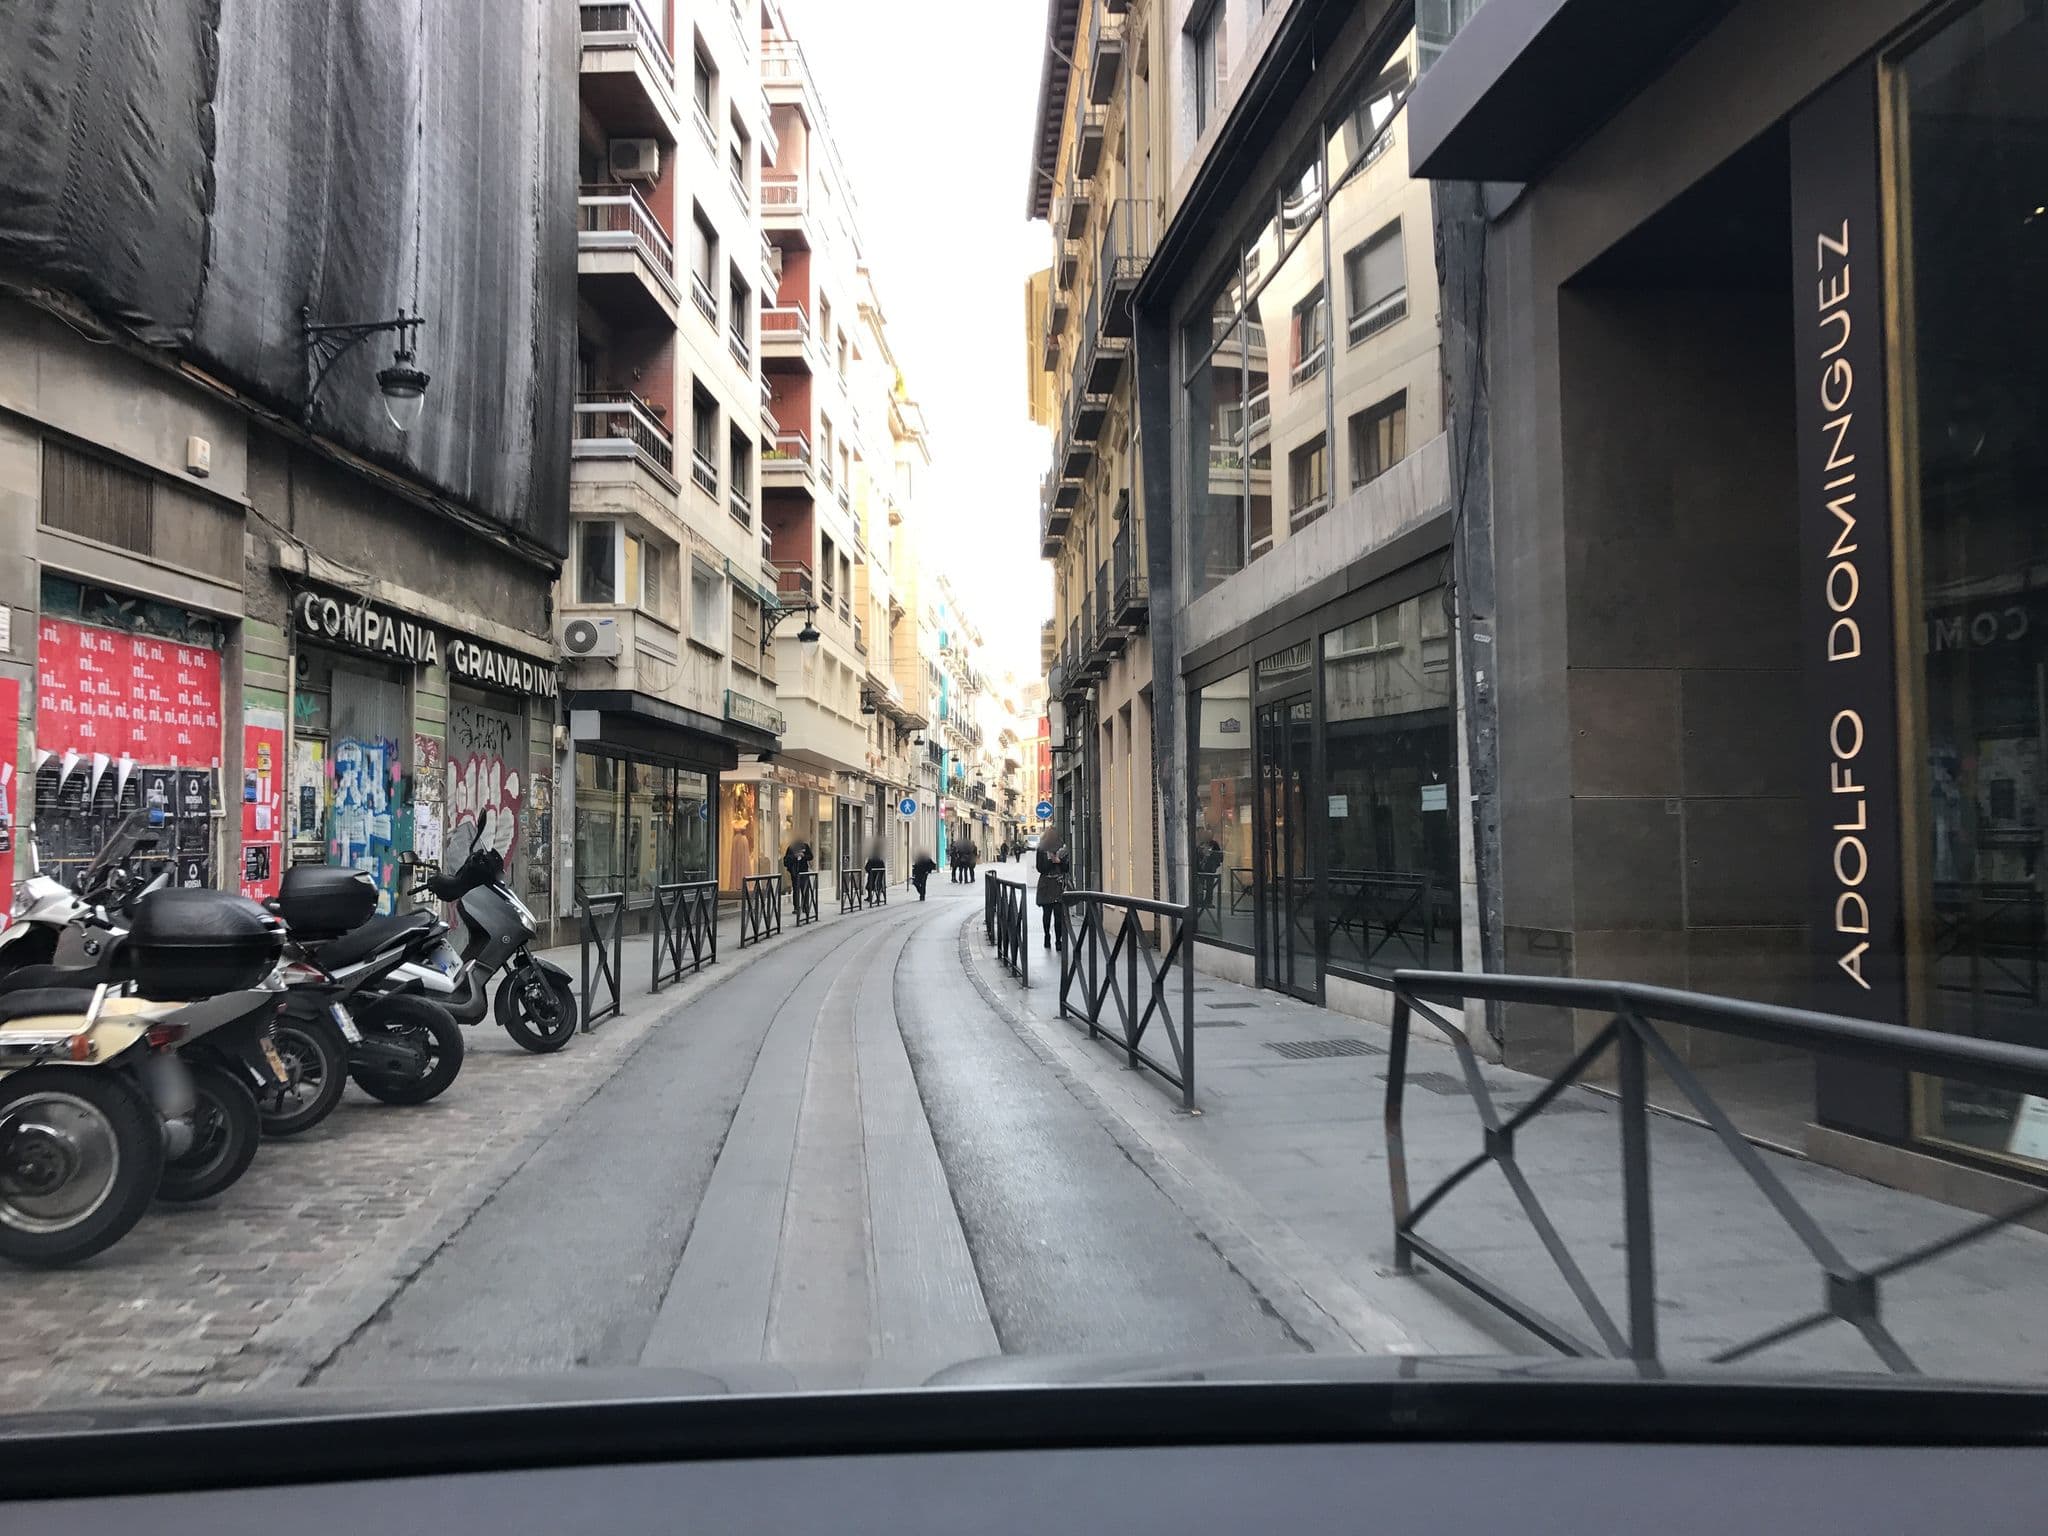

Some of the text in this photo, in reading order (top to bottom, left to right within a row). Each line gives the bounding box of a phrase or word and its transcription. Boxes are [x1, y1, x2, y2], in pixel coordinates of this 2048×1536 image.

[454, 639, 559, 699] GRANADINA
[1817, 217, 1871, 991] ADOLFO DOMINGUEZ
